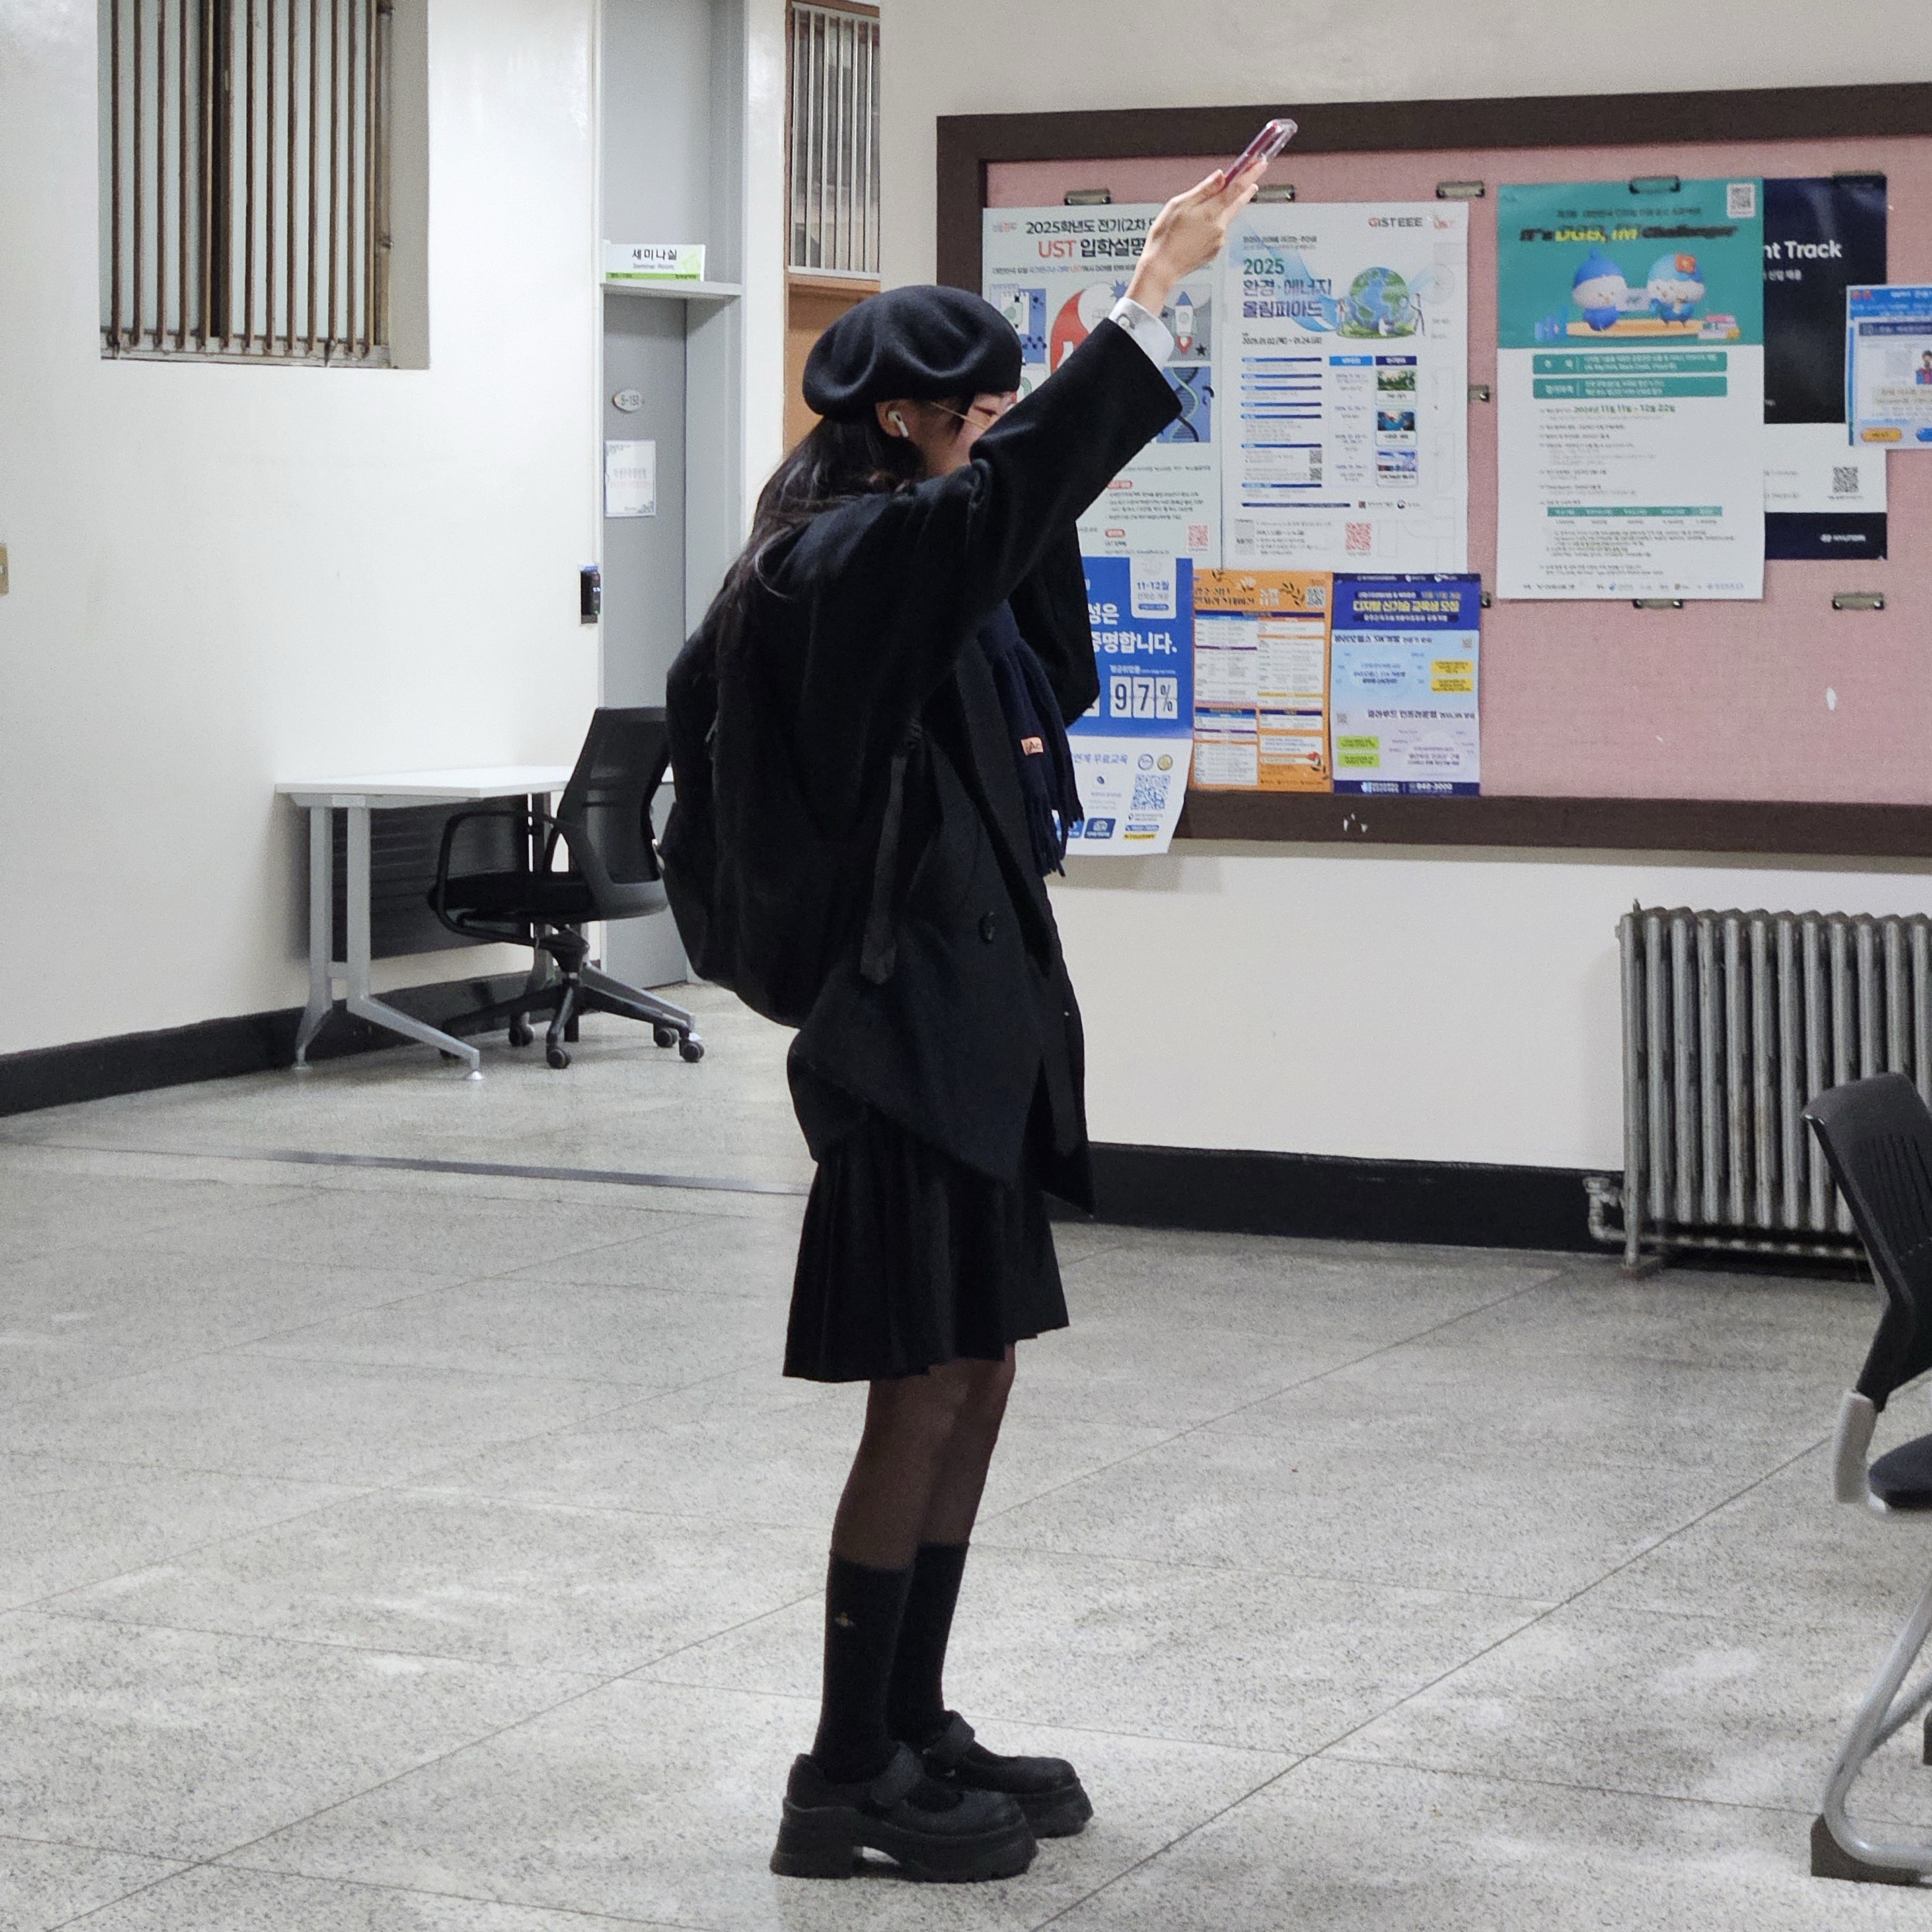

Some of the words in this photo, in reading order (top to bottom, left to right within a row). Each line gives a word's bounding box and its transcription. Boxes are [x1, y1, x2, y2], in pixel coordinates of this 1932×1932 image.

[1026, 220, 1095, 234] 2025학년도
[632, 249, 677, 260] 세미나실
[1038, 239, 1076, 258] UST
[1784, 238, 1843, 259] Track
[1243, 258, 1285, 275] 2025
[1243, 300, 1323, 318] 올림피아드
[1115, 683, 1173, 712] 97%
